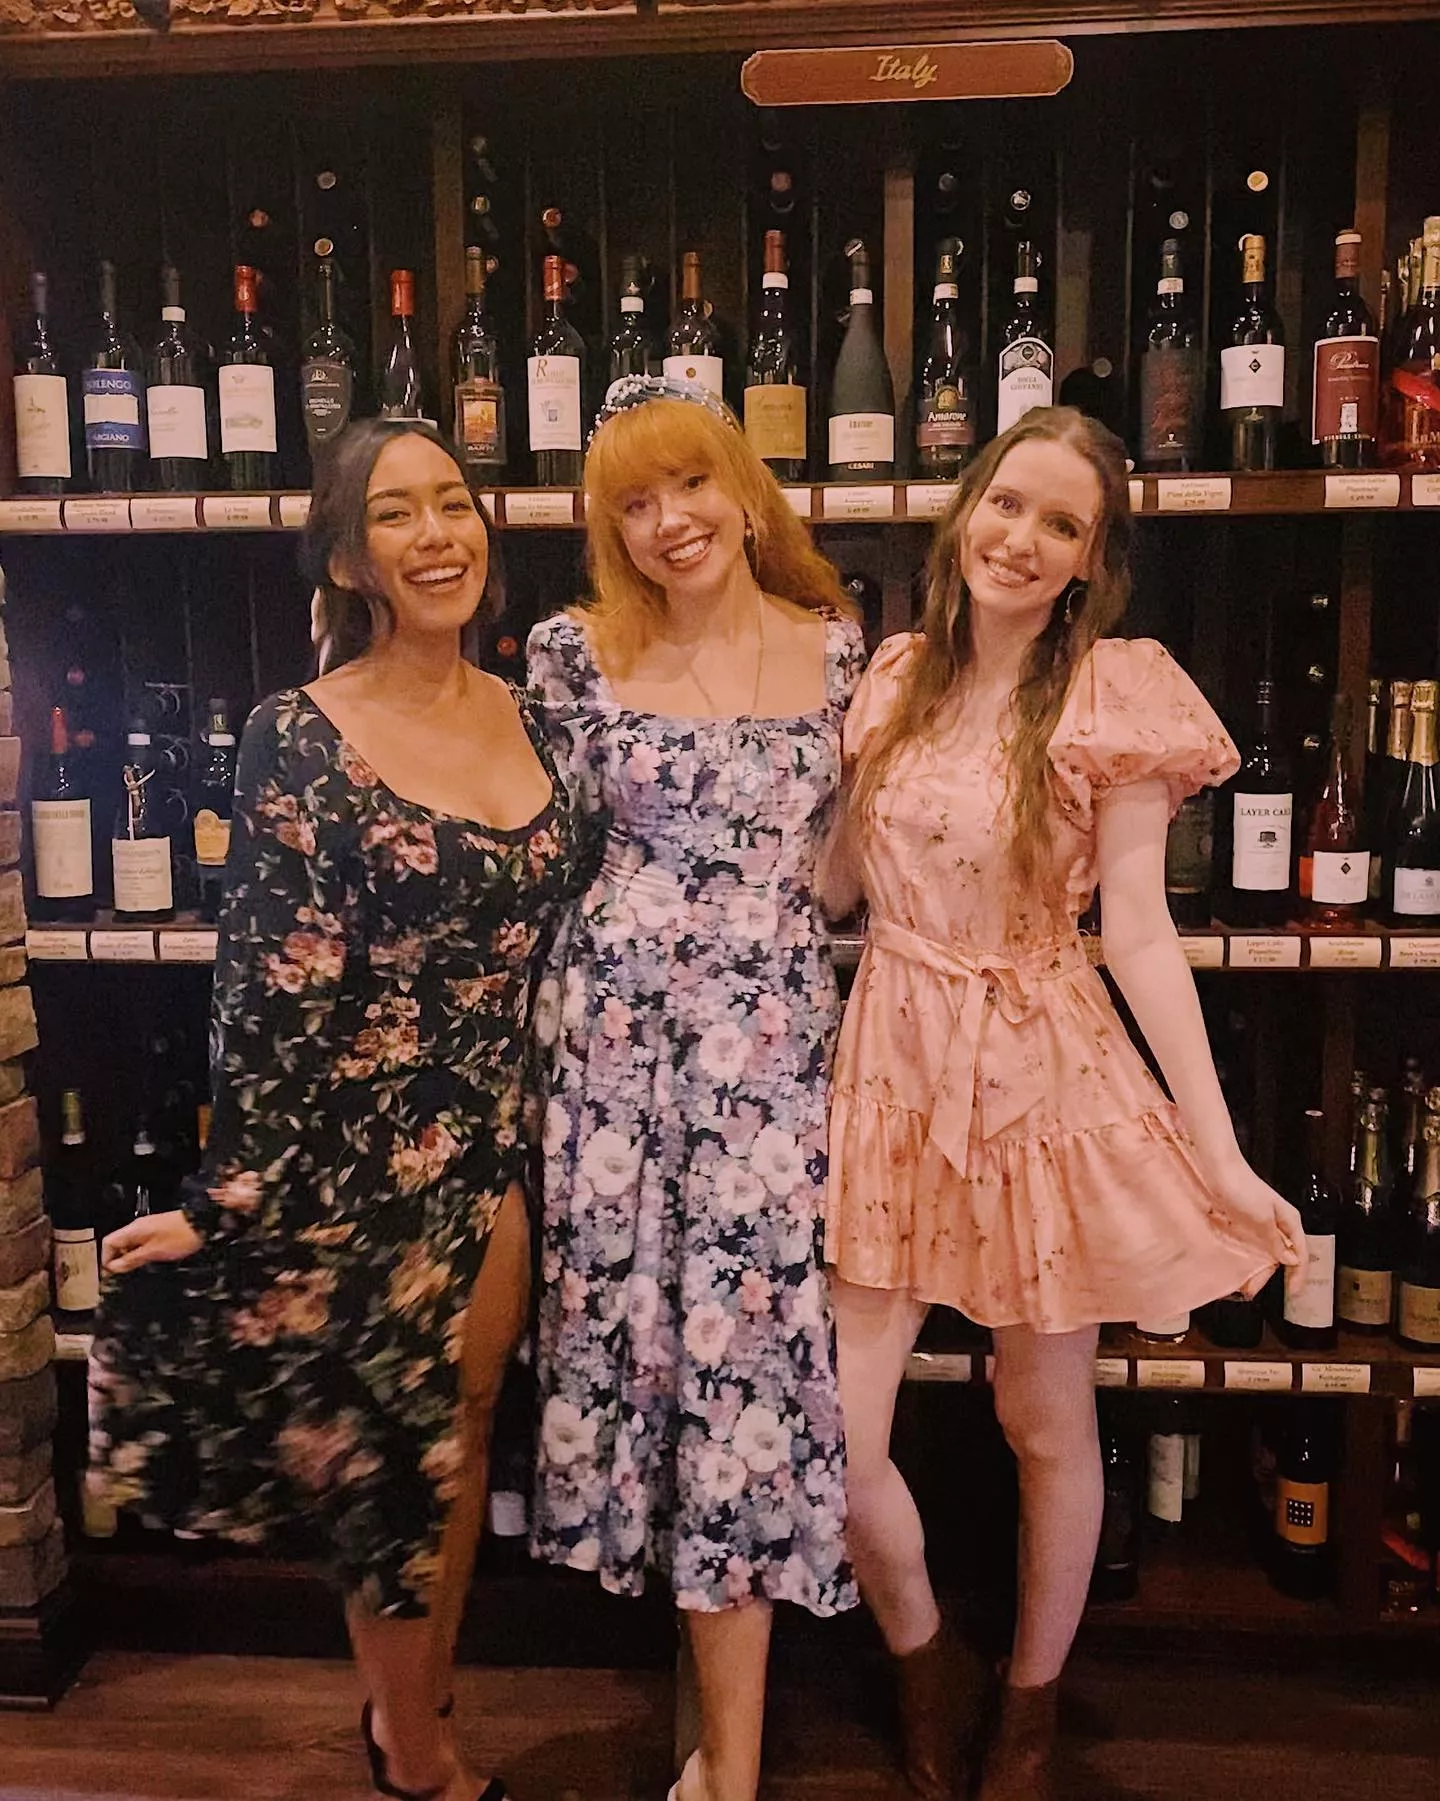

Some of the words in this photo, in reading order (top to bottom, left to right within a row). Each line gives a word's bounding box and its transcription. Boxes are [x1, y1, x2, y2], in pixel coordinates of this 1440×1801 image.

[869, 54, 938, 88] Italy
[928, 411, 967, 423] Amarone
[847, 462, 880, 471] CESARI
[1240, 808, 1270, 817] LAYER
